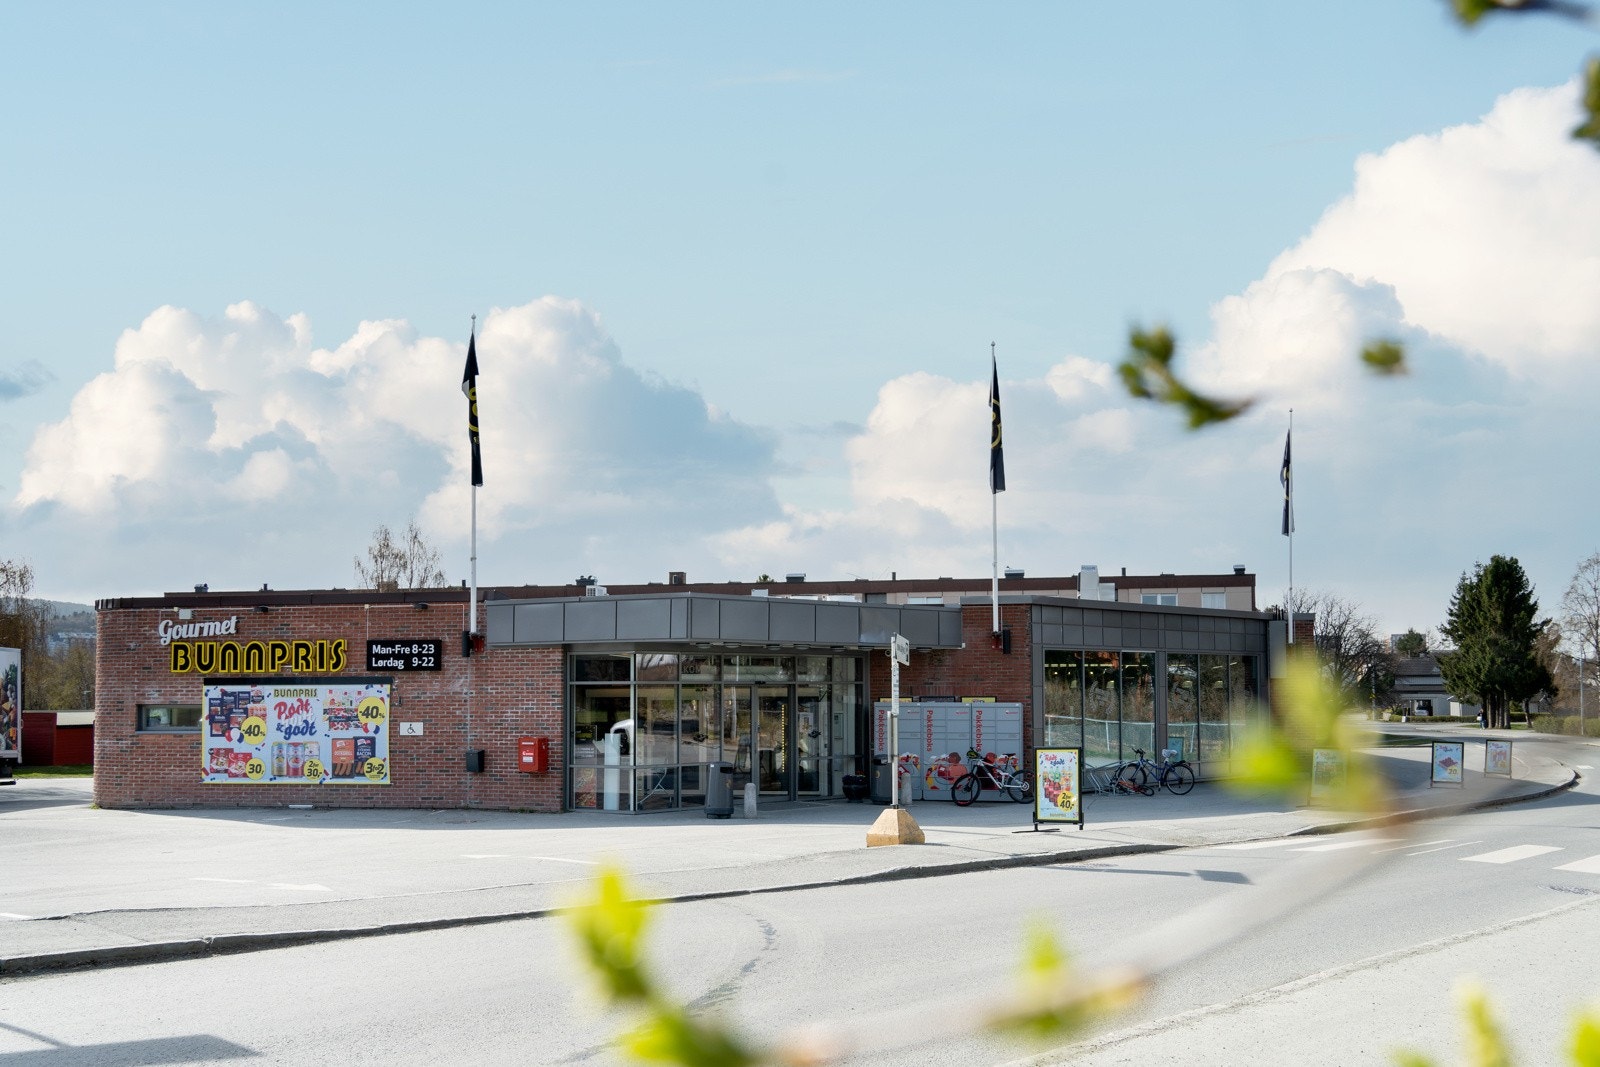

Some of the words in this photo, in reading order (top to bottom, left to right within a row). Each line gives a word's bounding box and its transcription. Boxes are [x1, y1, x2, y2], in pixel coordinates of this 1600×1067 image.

[159, 616, 237, 645] Gourmet
[372, 644, 410, 654] Man-Fre
[412, 644, 434, 654] 8-23
[171, 639, 347, 674] BUNNPRIS
[372, 657, 404, 669] Lørdag
[412, 657, 434, 667] 9-22
[273, 688, 318, 697] BUNNPRIS
